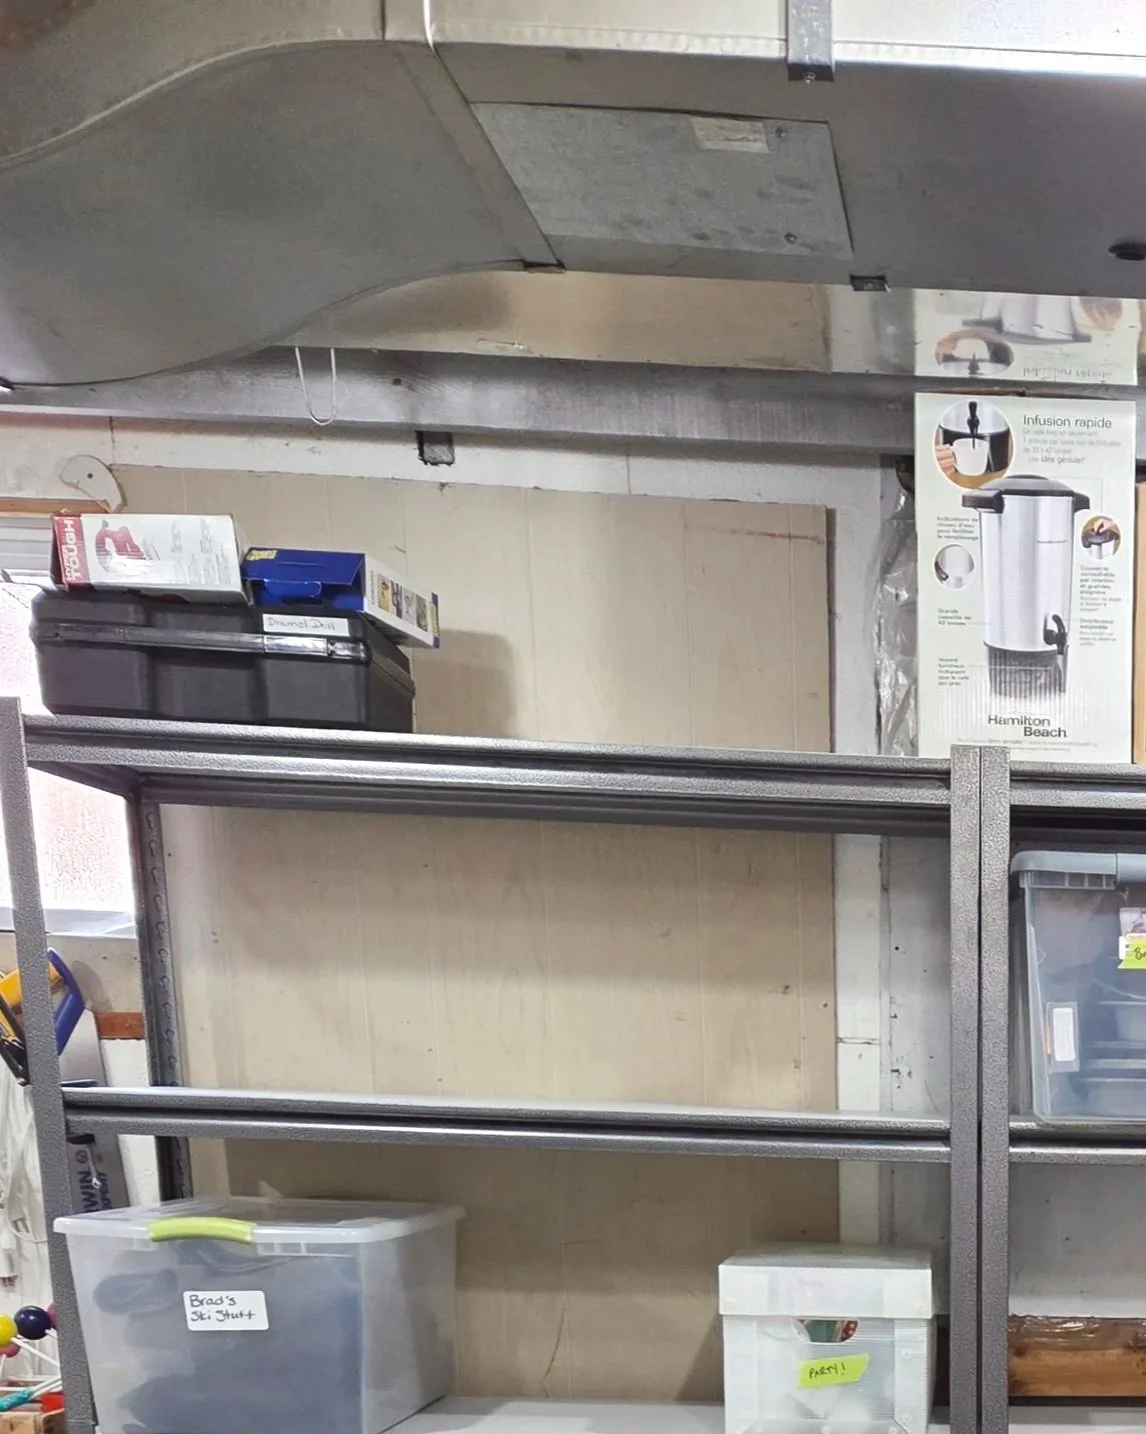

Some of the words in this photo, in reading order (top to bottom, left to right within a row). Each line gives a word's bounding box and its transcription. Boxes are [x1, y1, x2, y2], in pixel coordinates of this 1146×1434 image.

[1023, 414, 1071, 427] Infusion
[1075, 417, 1112, 429] rapide
[64, 519, 82, 580] TOUGH
[267, 616, 308, 629] Dremel
[311, 618, 336, 631] Drill
[987, 714, 1051, 727] Hamilton
[1023, 726, 1068, 739] Beach
[189, 1294, 238, 1308] Brad's
[190, 1309, 212, 1322] Ski
[215, 1309, 257, 1323] Stuff
